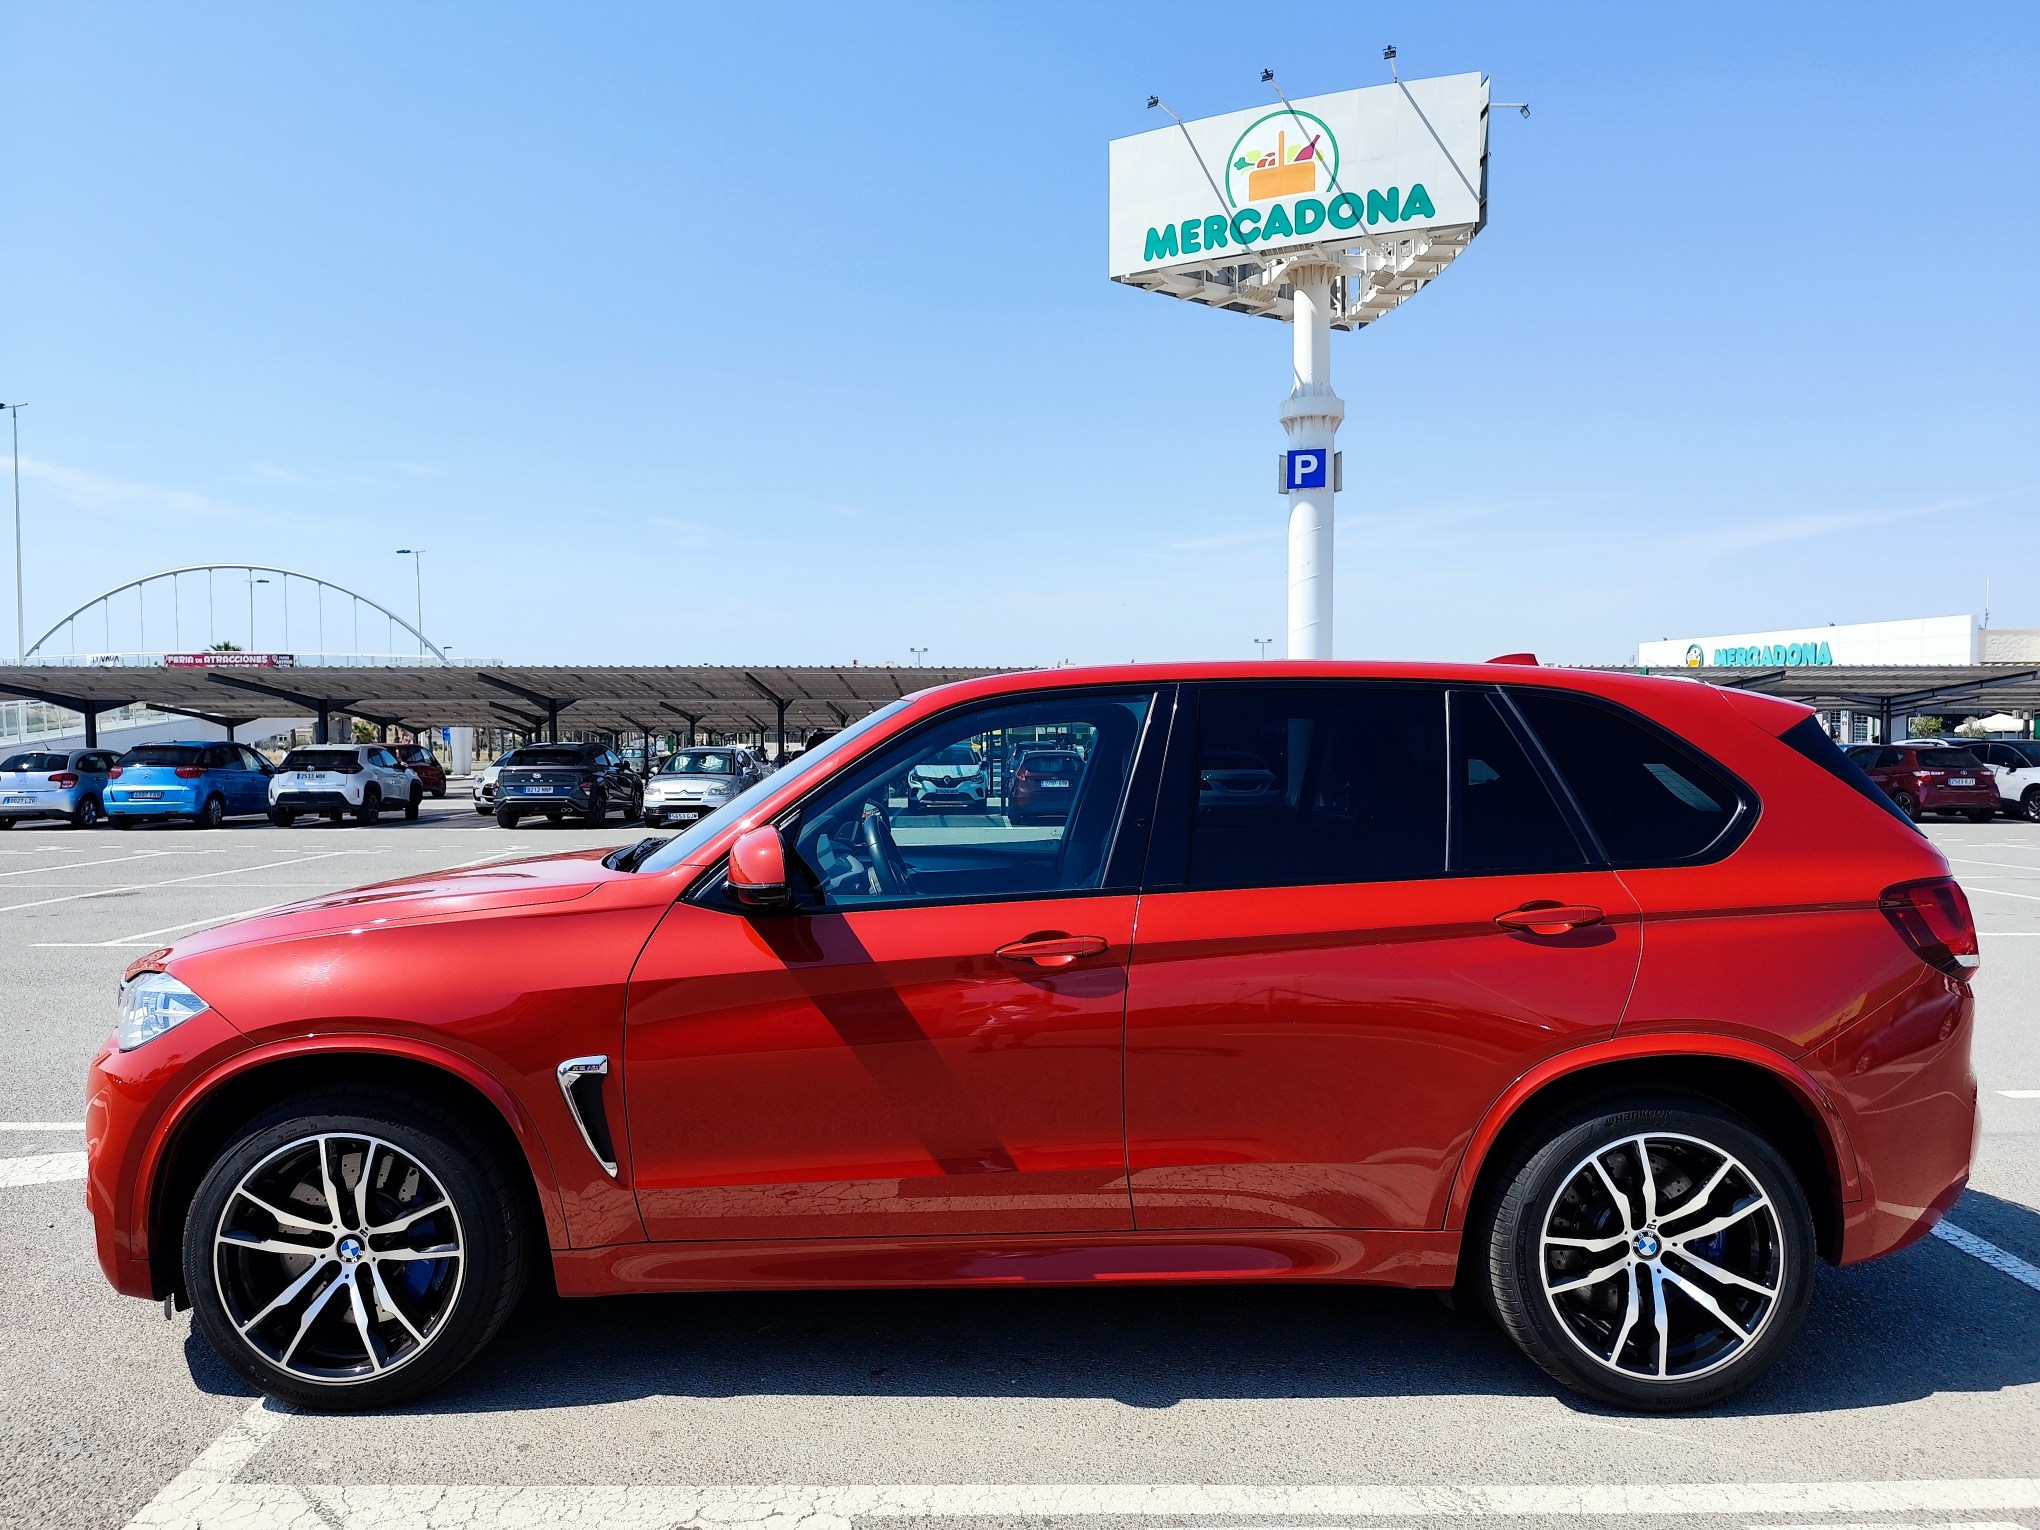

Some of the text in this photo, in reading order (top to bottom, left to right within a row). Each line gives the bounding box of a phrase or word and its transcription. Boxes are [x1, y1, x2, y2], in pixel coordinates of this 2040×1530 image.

[1143, 182, 1436, 262] MERCADONA
[1294, 455, 1319, 485] P
[168, 655, 194, 664] FERIA
[203, 655, 268, 664] ATRACCIONES
[1713, 641, 1833, 666] MERCADONA
